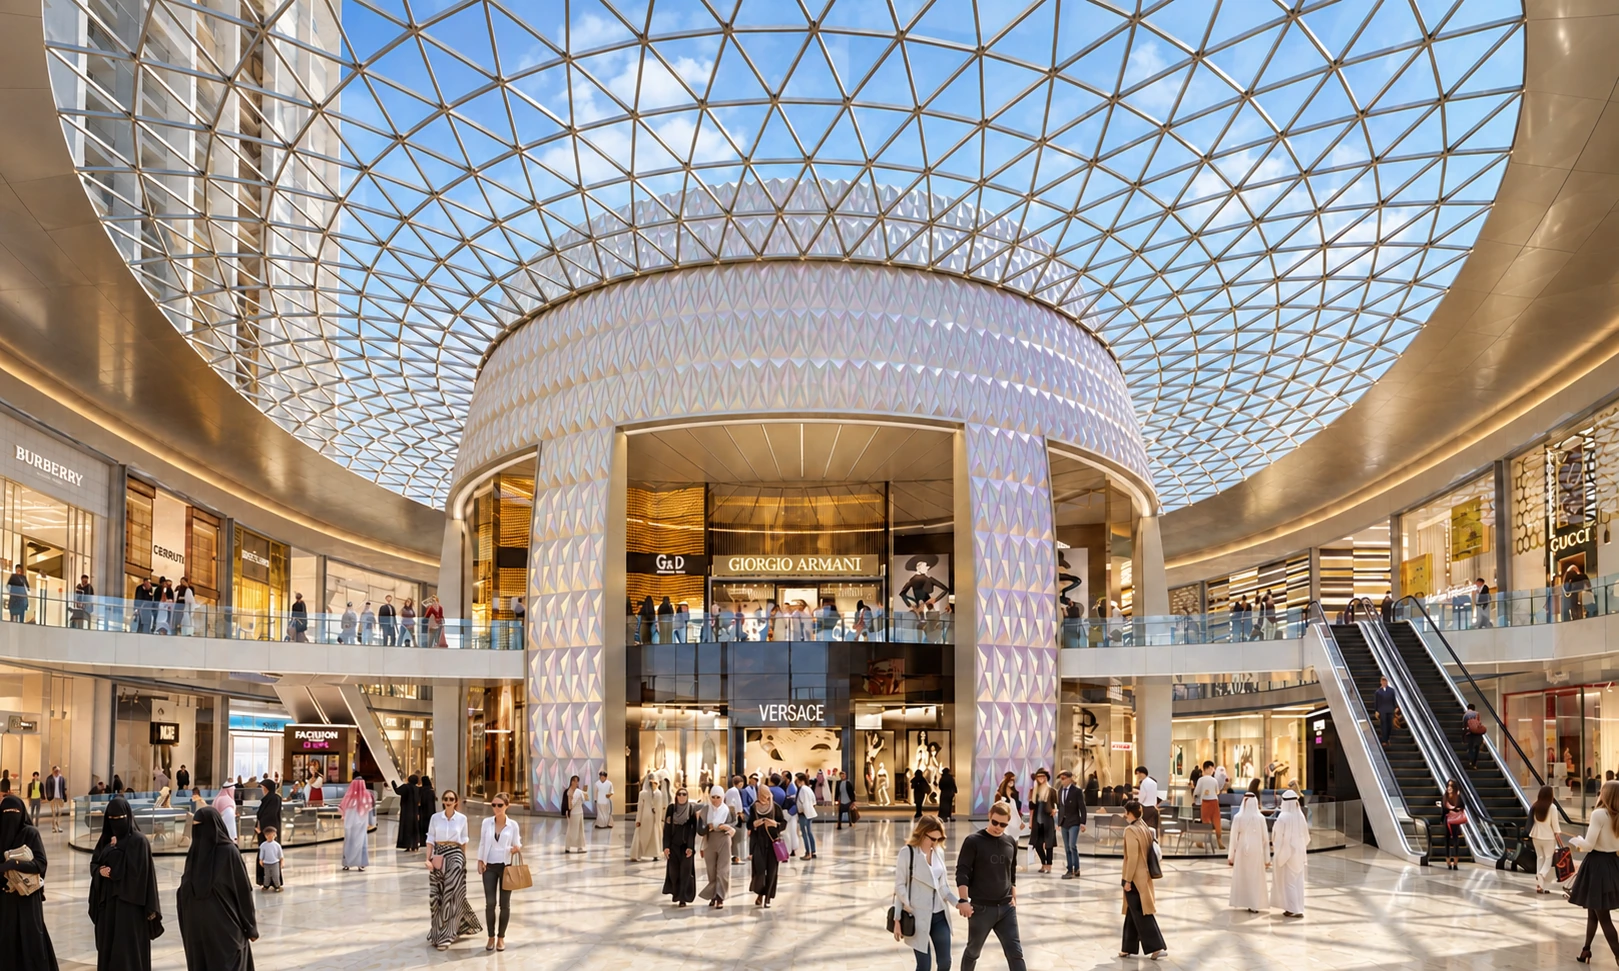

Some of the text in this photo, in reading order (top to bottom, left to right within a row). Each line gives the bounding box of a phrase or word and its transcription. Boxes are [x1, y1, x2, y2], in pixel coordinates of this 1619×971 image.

[15, 444, 83, 487] BURBERRY
[1550, 528, 1590, 552] GUCCI
[656, 554, 685, 570] G&D
[728, 557, 862, 572] GIORGIO ARMANI
[759, 704, 825, 721] VERSACE
